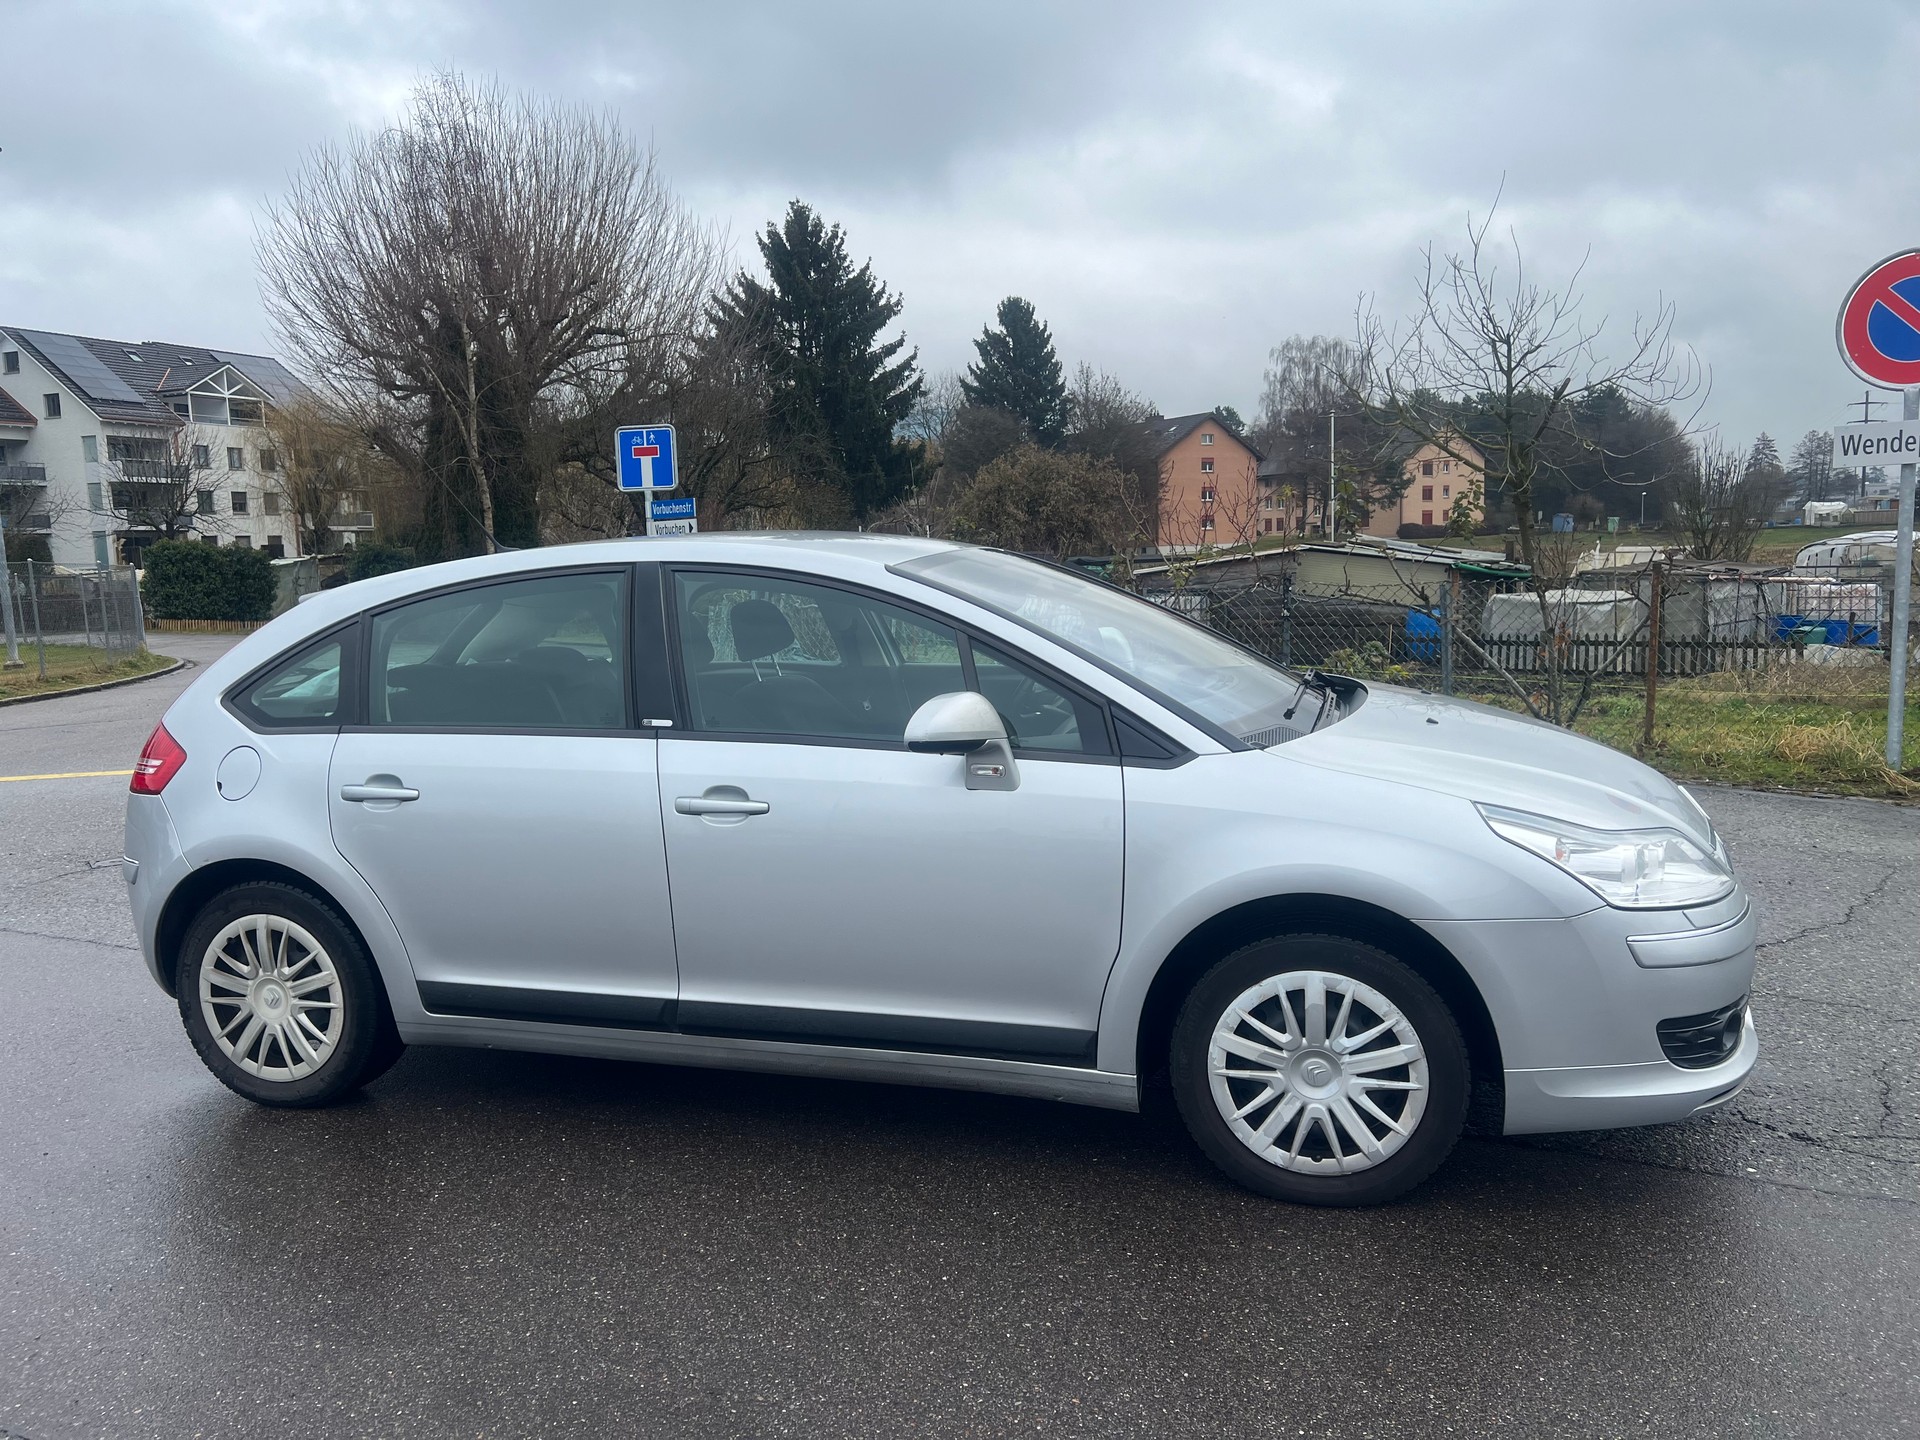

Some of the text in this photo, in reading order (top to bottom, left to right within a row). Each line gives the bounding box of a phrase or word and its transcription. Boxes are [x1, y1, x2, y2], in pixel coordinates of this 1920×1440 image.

[1841, 429, 1920, 457] Wende
[652, 502, 693, 515] Vorbuchenstr.
[654, 523, 686, 535] Vorbuchen
